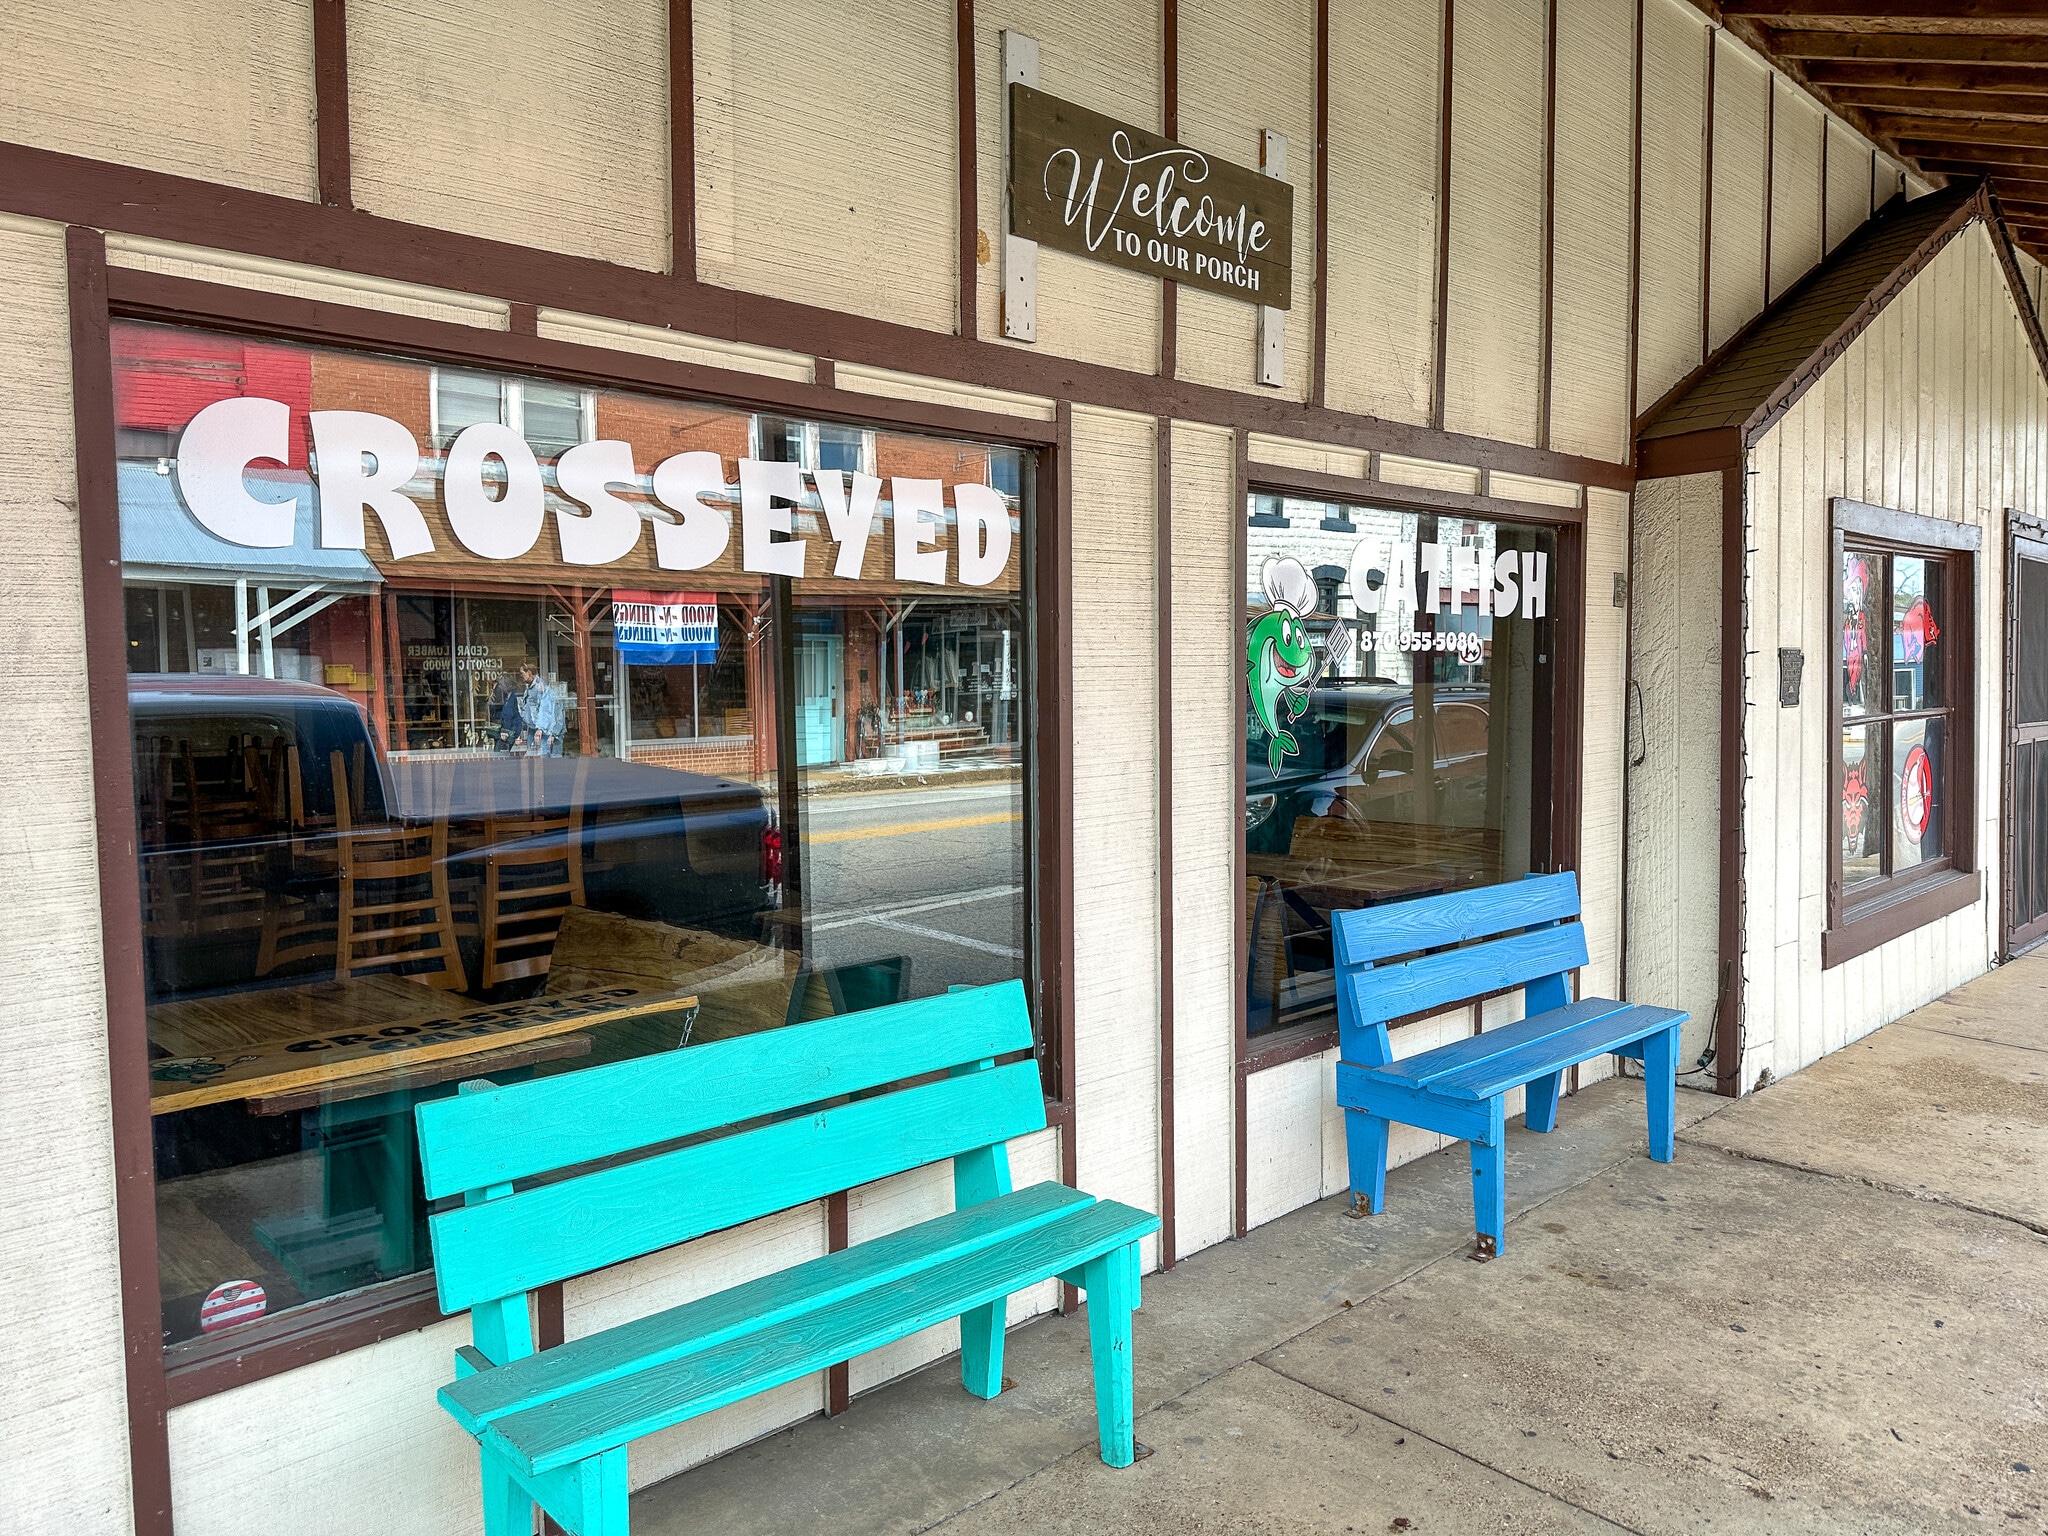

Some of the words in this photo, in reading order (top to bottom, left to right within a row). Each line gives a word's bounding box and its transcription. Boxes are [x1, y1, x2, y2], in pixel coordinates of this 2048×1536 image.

[1044, 130, 1272, 265] Welcome
[1112, 227, 1141, 257] TO
[1147, 238, 1190, 272] OUR
[1195, 252, 1260, 292] PORCH
[177, 396, 1012, 587] CROSSEYED
[1350, 536, 1548, 620] CATFISH
[1360, 630, 1479, 653] 870-955-5080
[284, 988, 640, 1053] CROSSEYED
[367, 1001, 627, 1052] CATFISH
